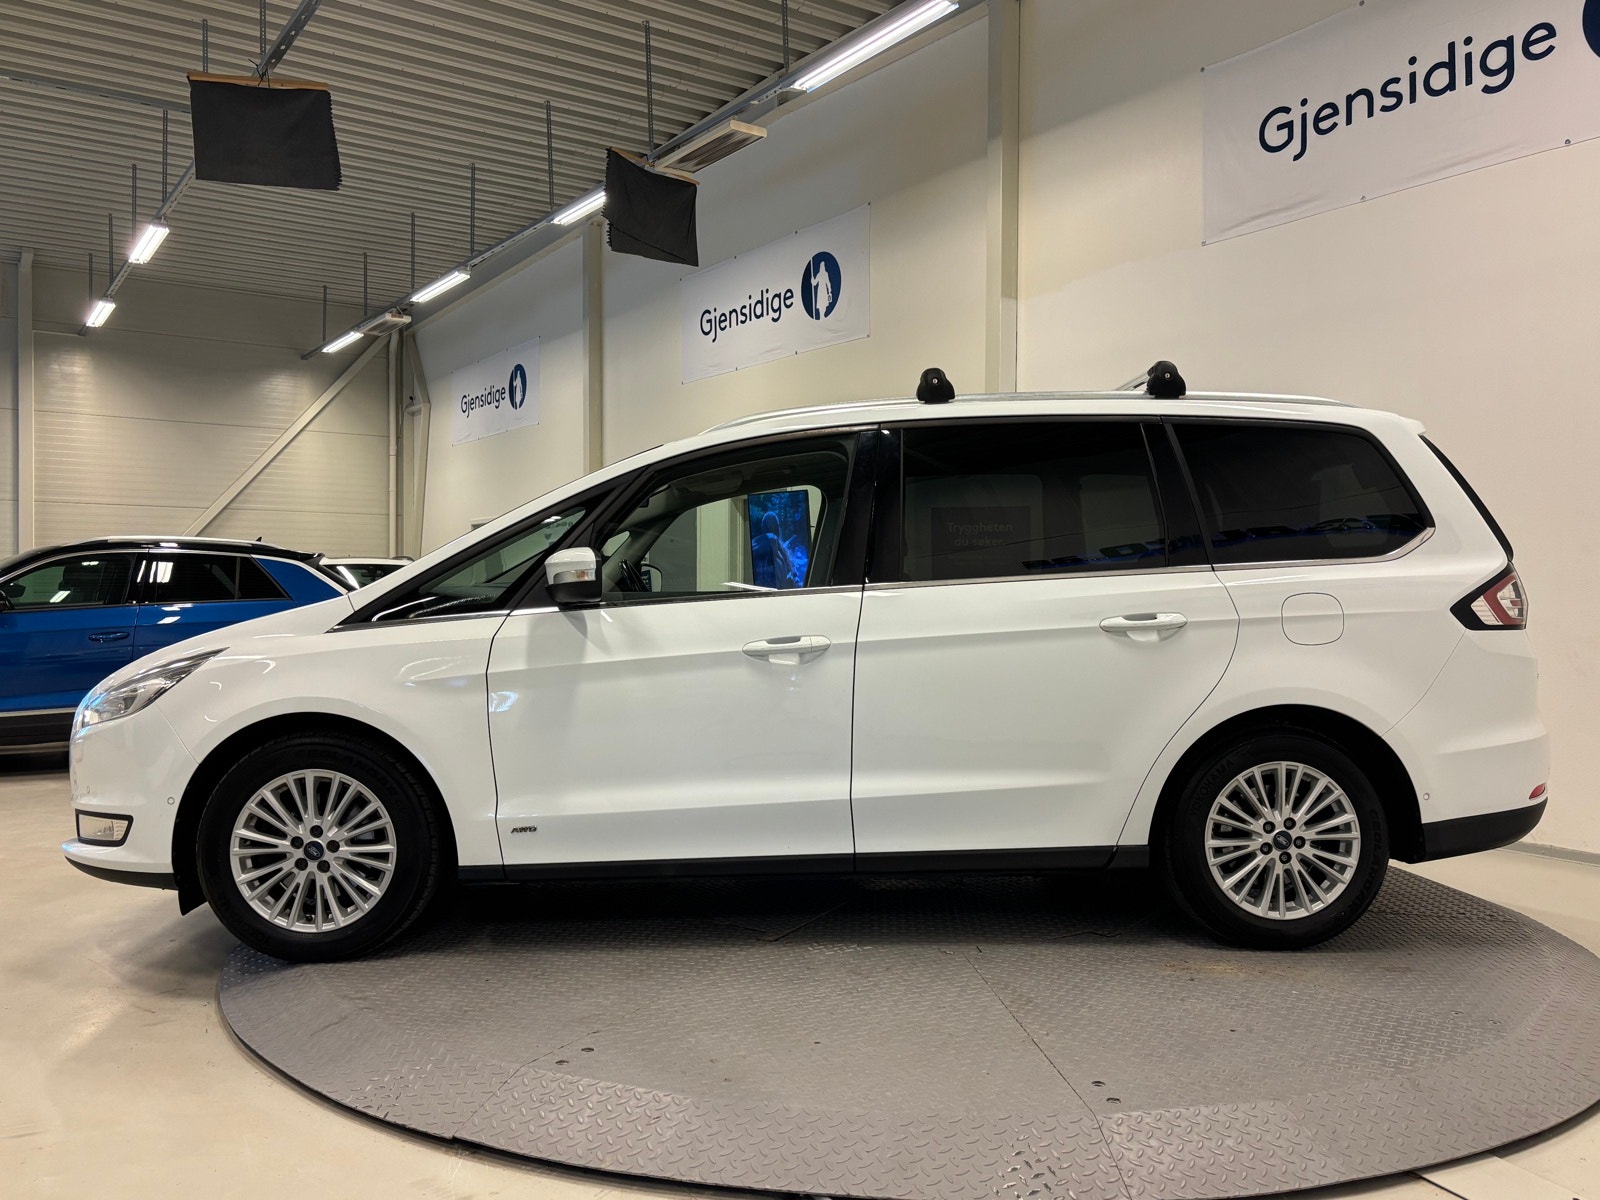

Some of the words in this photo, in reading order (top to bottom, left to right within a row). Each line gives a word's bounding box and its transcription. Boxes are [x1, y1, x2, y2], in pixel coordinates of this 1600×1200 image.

[1258, 22, 1557, 162] Gjensidige
[700, 288, 794, 343] Gjensidige
[460, 384, 506, 418] Gjensidige
[946, 522, 1014, 535] Tryggheten
[953, 537, 969, 547] du
